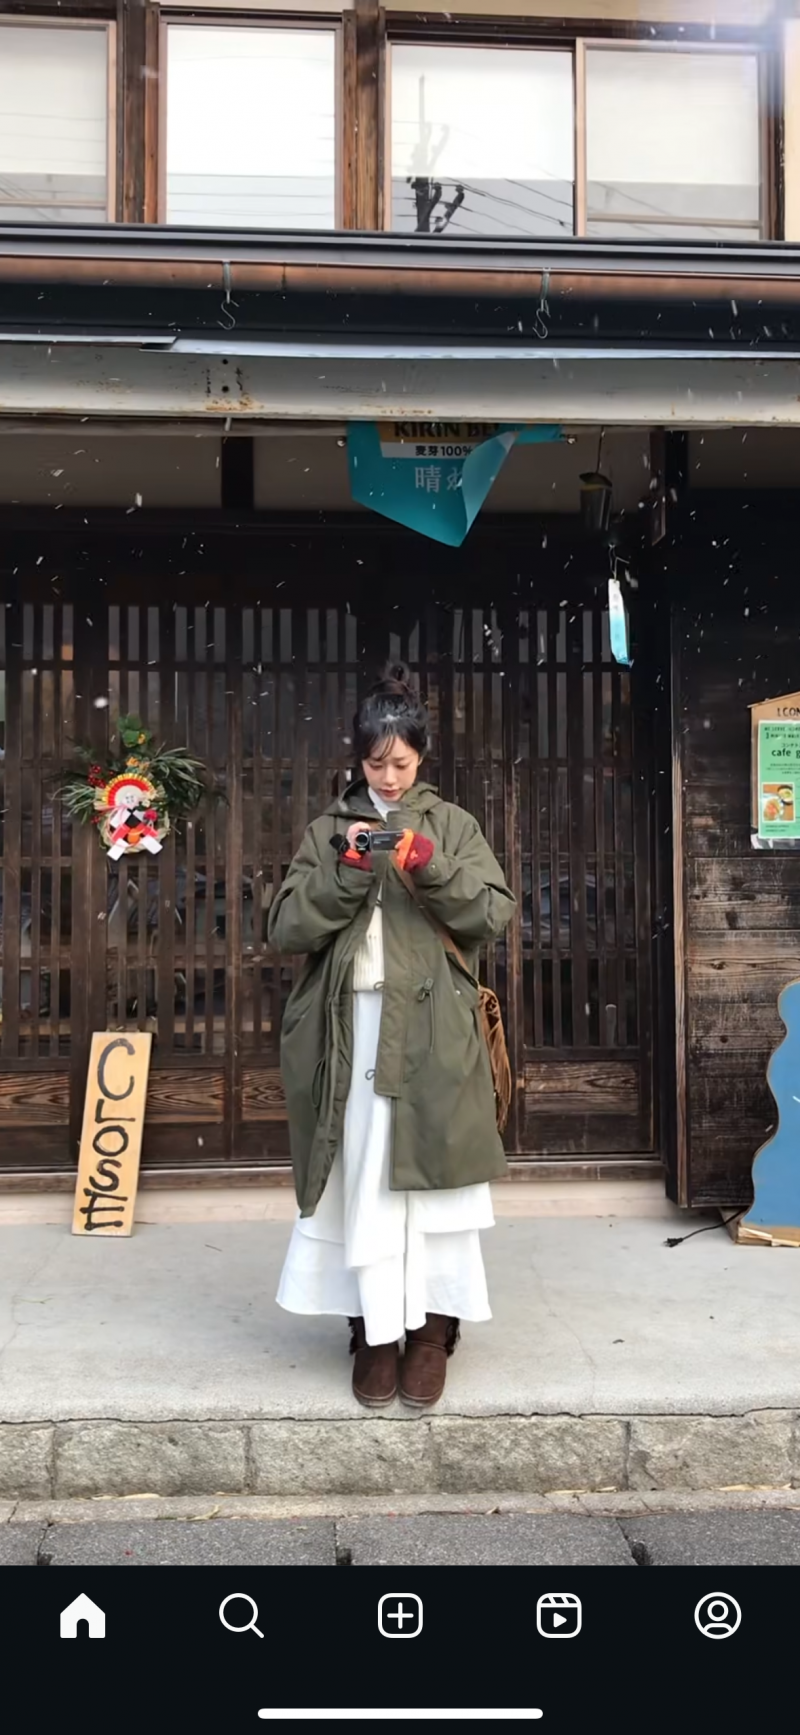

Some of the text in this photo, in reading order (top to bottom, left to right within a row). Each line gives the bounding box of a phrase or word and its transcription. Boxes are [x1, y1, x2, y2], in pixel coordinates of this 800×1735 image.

[394, 422, 460, 437] KIRIN
[771, 748, 791, 757] cafe
[80, 1037, 136, 1231] CLOSE
